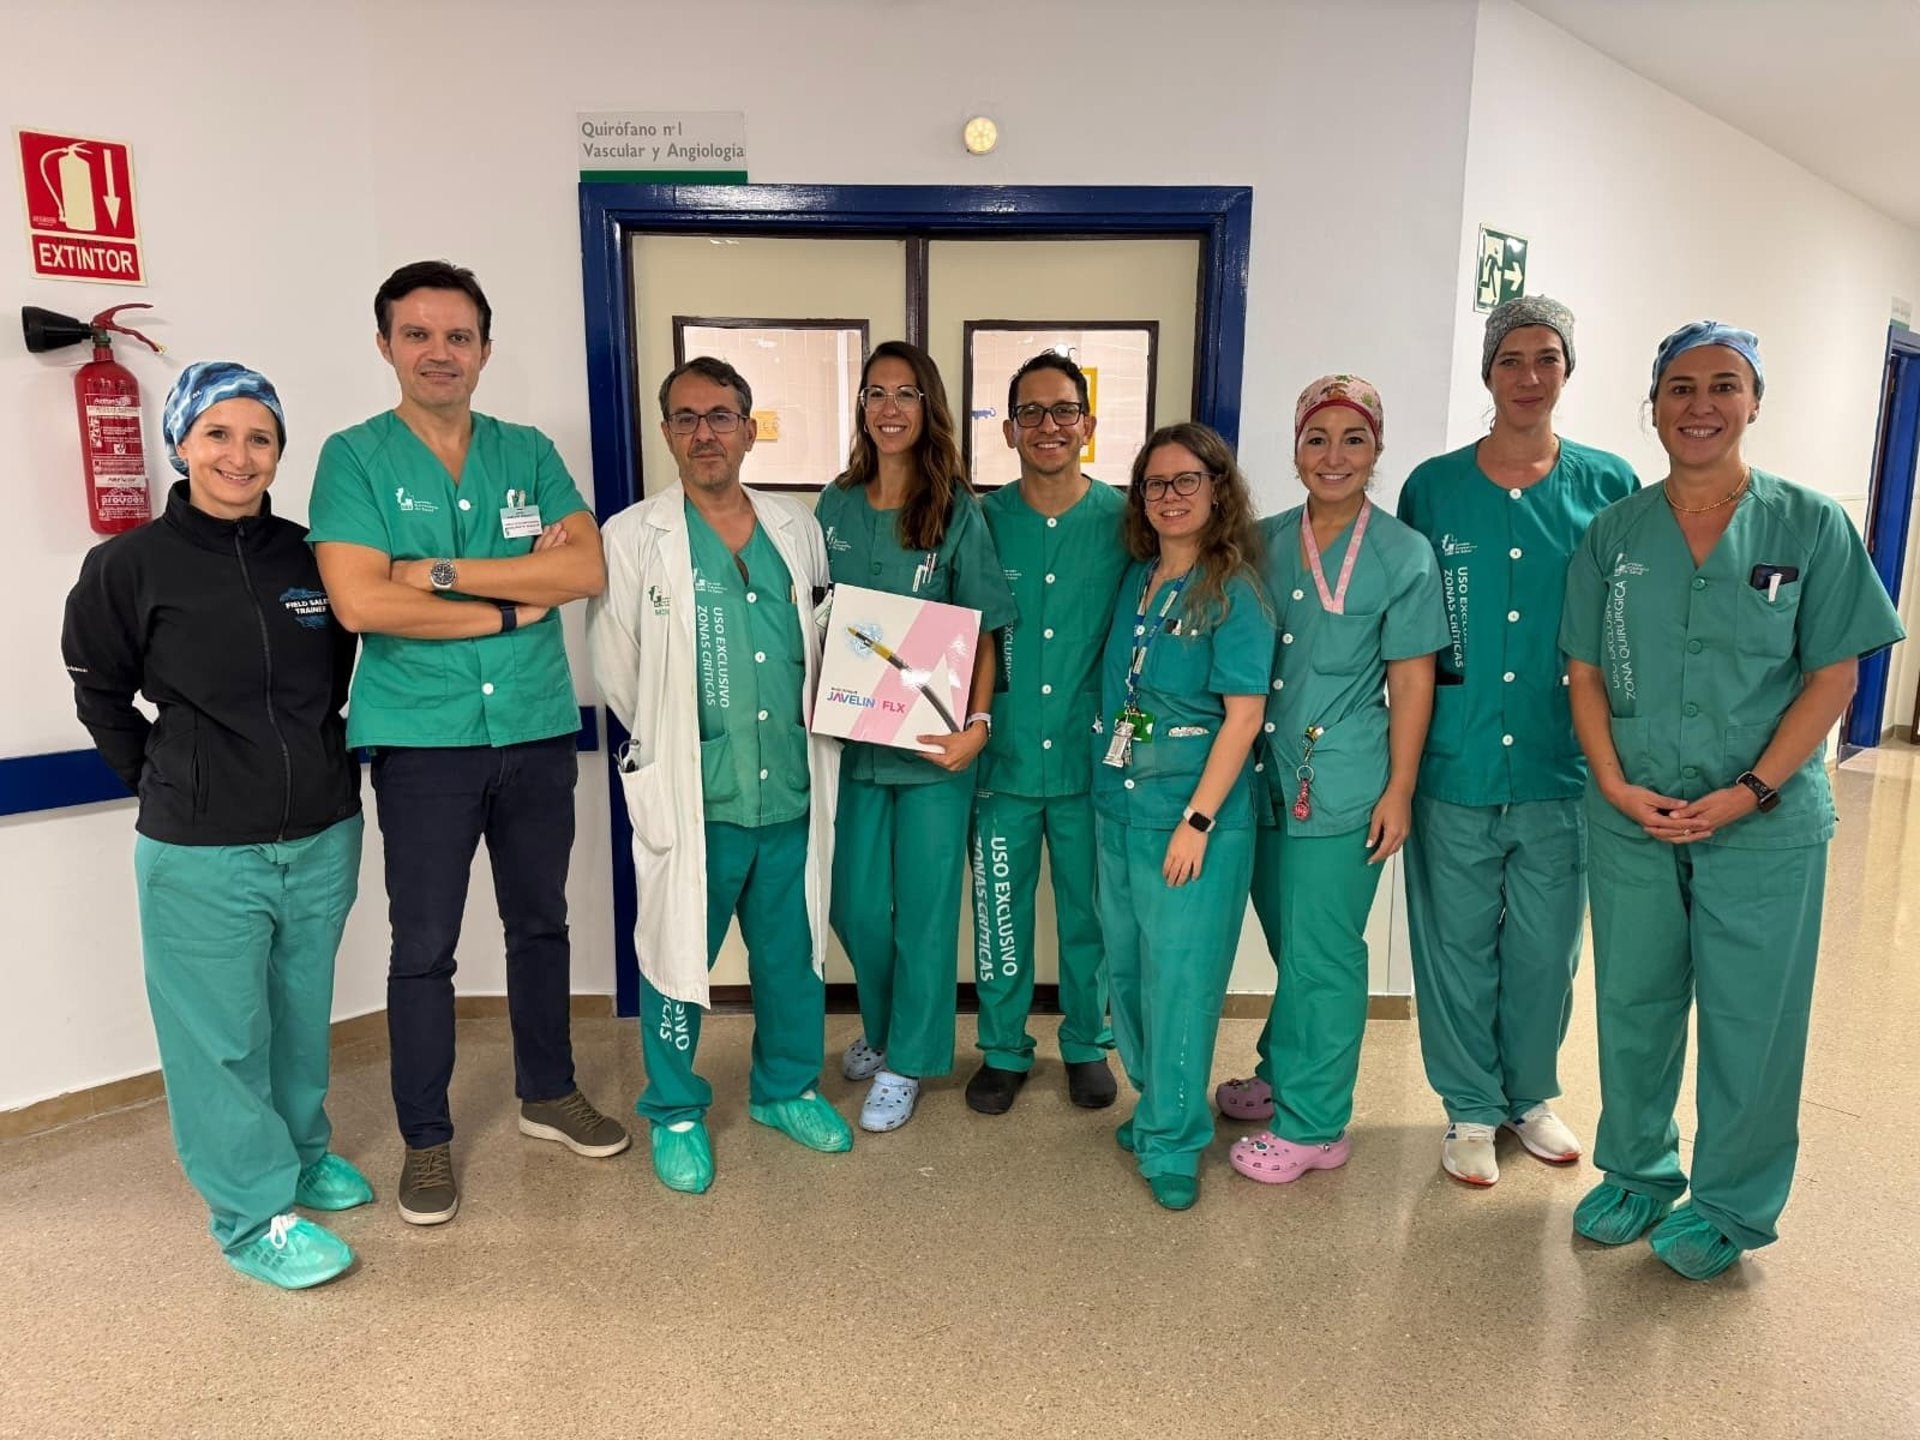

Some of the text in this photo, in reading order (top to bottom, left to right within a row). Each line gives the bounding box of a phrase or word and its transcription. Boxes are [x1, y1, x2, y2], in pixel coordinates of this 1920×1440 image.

[581, 121, 657, 138] Quirófano
[583, 142, 745, 162] Vascular y Angiología
[38, 242, 135, 274] EXTINTOR
[1444, 568, 1456, 611] ZONAS
[1458, 566, 1468, 594] USO
[697, 605, 711, 649] ZONAS
[713, 606, 725, 634] USO
[715, 637, 730, 708] EXCLUSIVO
[1622, 661, 1637, 700] ZONA
[826, 691, 906, 714] JAVELIN FLX
[990, 837, 1018, 977] USO EXCLUSIVO
